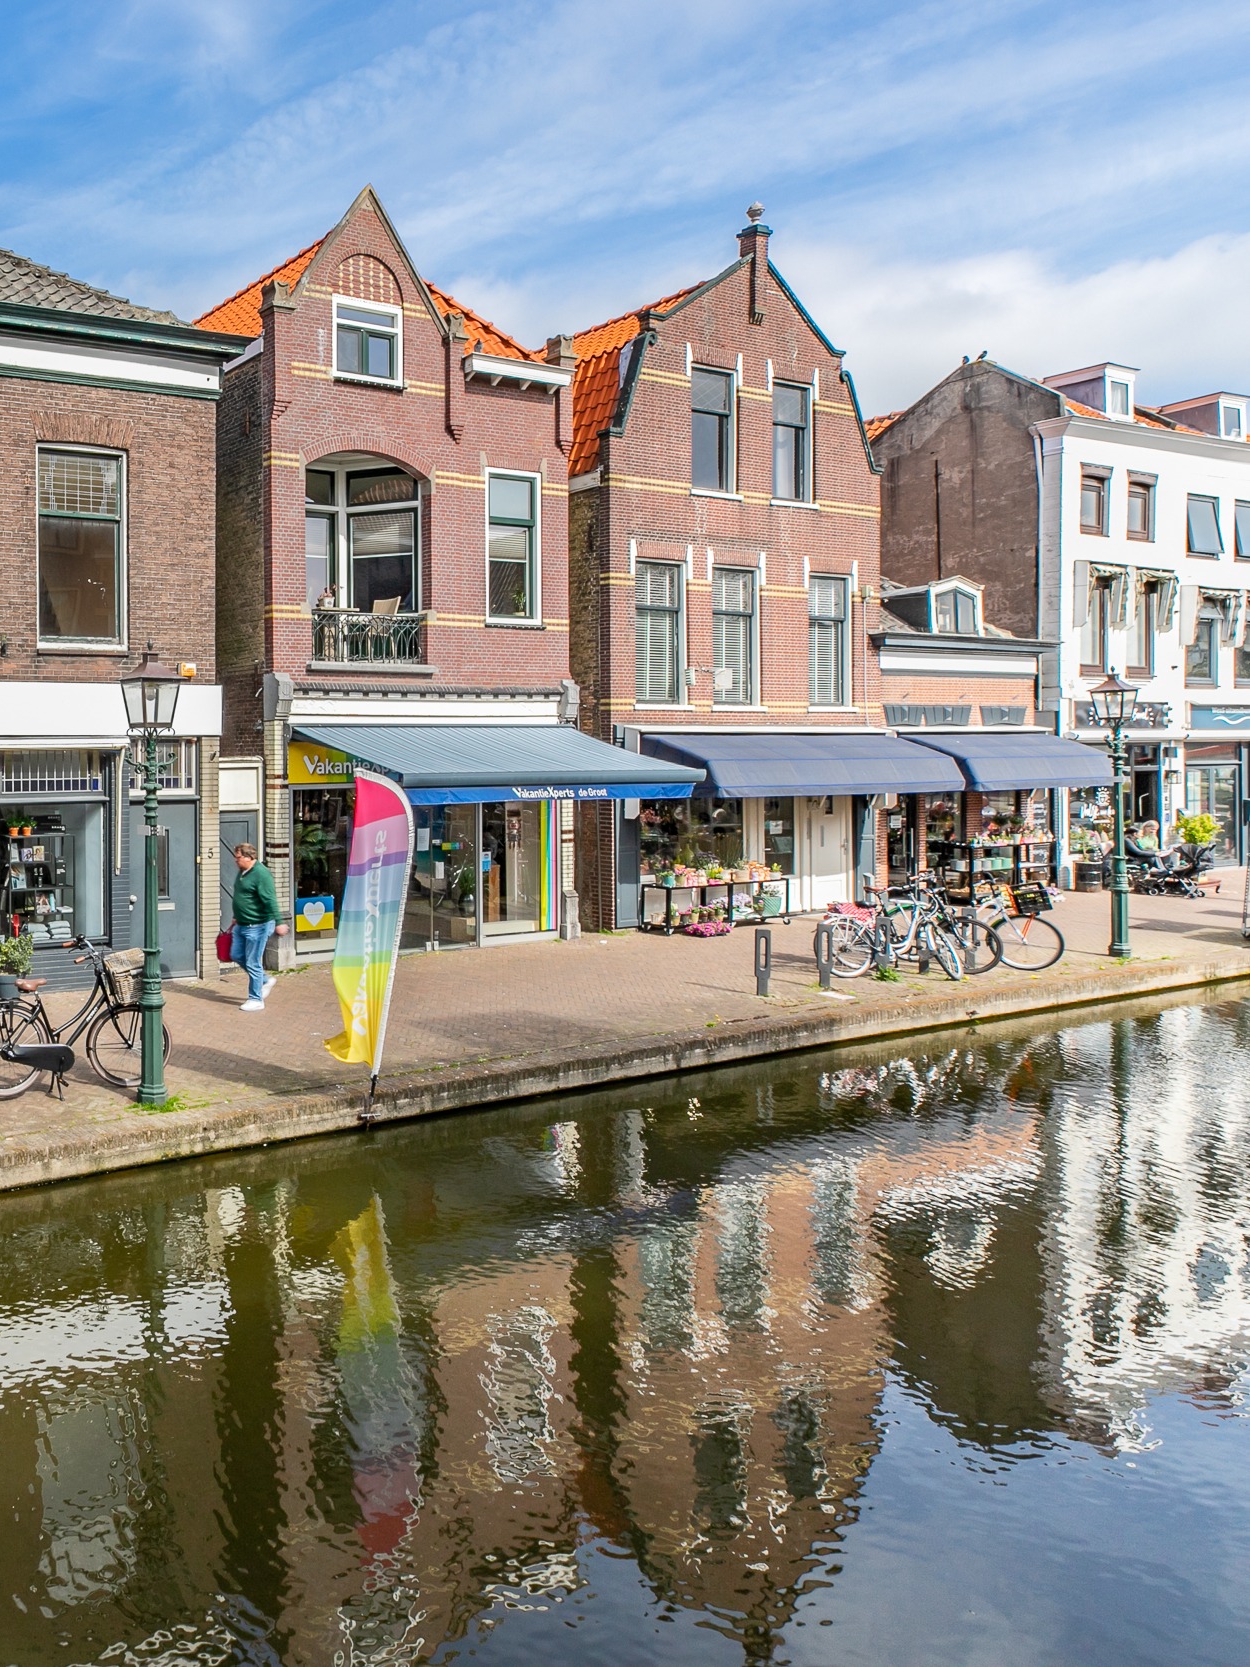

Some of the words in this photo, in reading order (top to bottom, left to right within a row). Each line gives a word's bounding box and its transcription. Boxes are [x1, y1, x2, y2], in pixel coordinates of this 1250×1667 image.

[512, 786, 575, 799] VakantieXperts
[578, 788, 588, 797] de
[587, 787, 608, 797] Groot
[207, 848, 213, 859] 5
